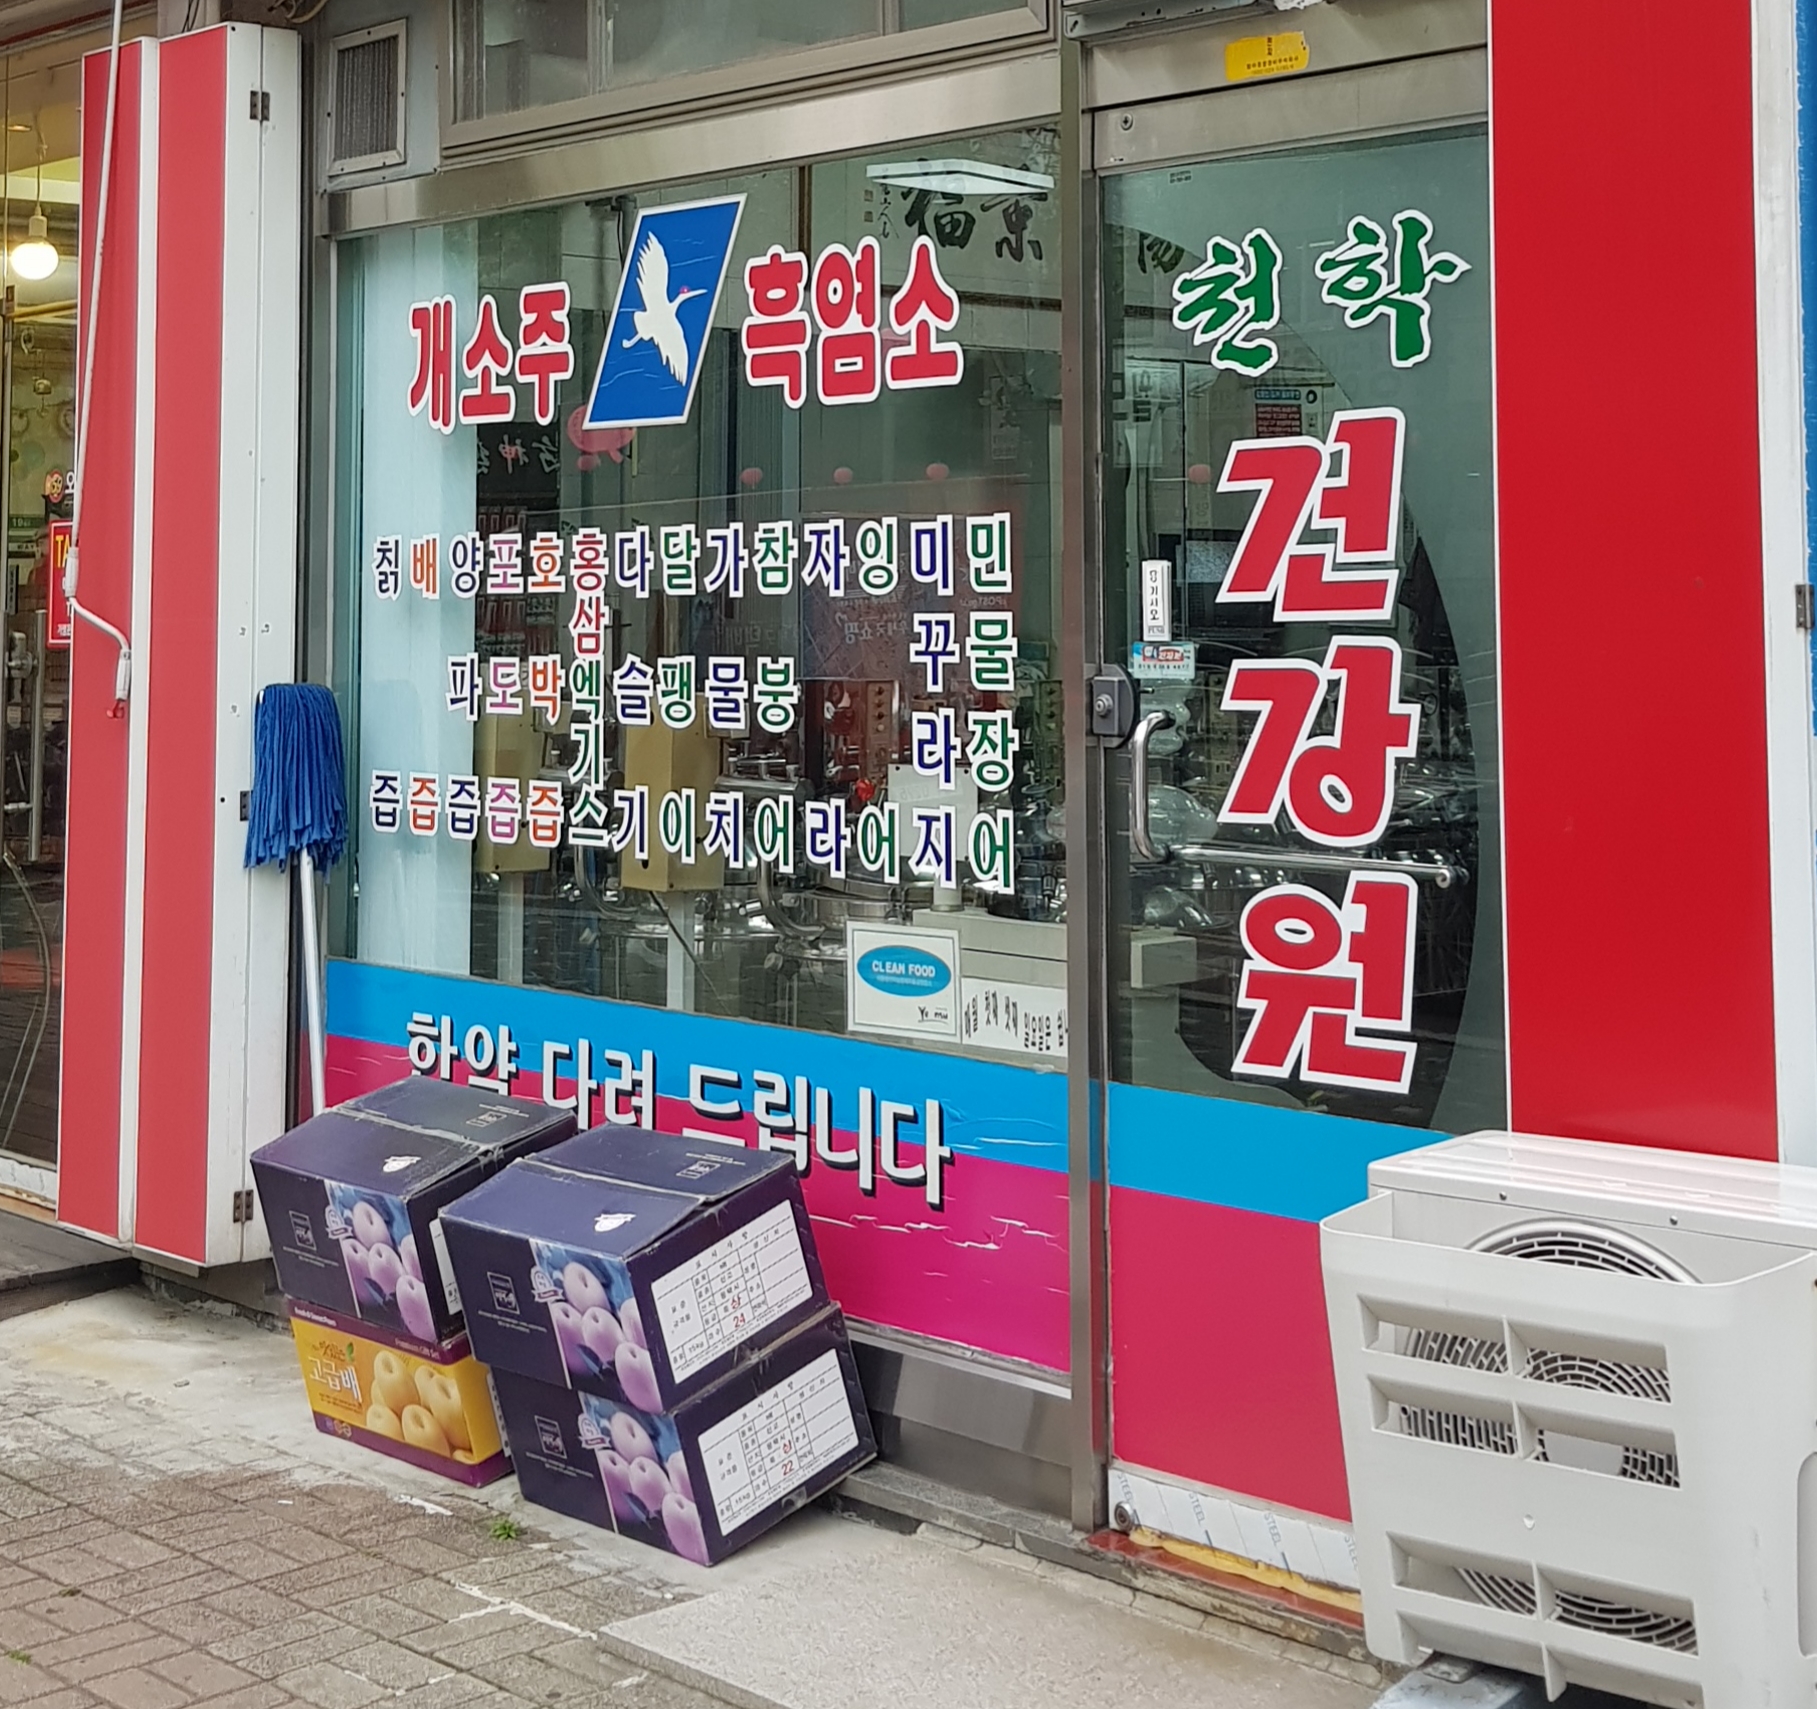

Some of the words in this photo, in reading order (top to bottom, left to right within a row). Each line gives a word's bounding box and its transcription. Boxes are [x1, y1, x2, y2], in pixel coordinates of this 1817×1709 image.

[741, 234, 964, 409] 흑염소
[407, 280, 575, 435] 개소주
[1215, 406, 1420, 1096] 건강원
[872, 959, 906, 975] CLEAN
[908, 963, 936, 978] FOOD
[543, 1038, 655, 1131] 다려
[681, 1063, 953, 1206] 드립니다
[308, 1356, 362, 1403] 고급배
[1117, 1472, 1133, 1503] STEEL
[1189, 1492, 1206, 1523] STEEL
[1264, 1512, 1283, 1546] STEEL
